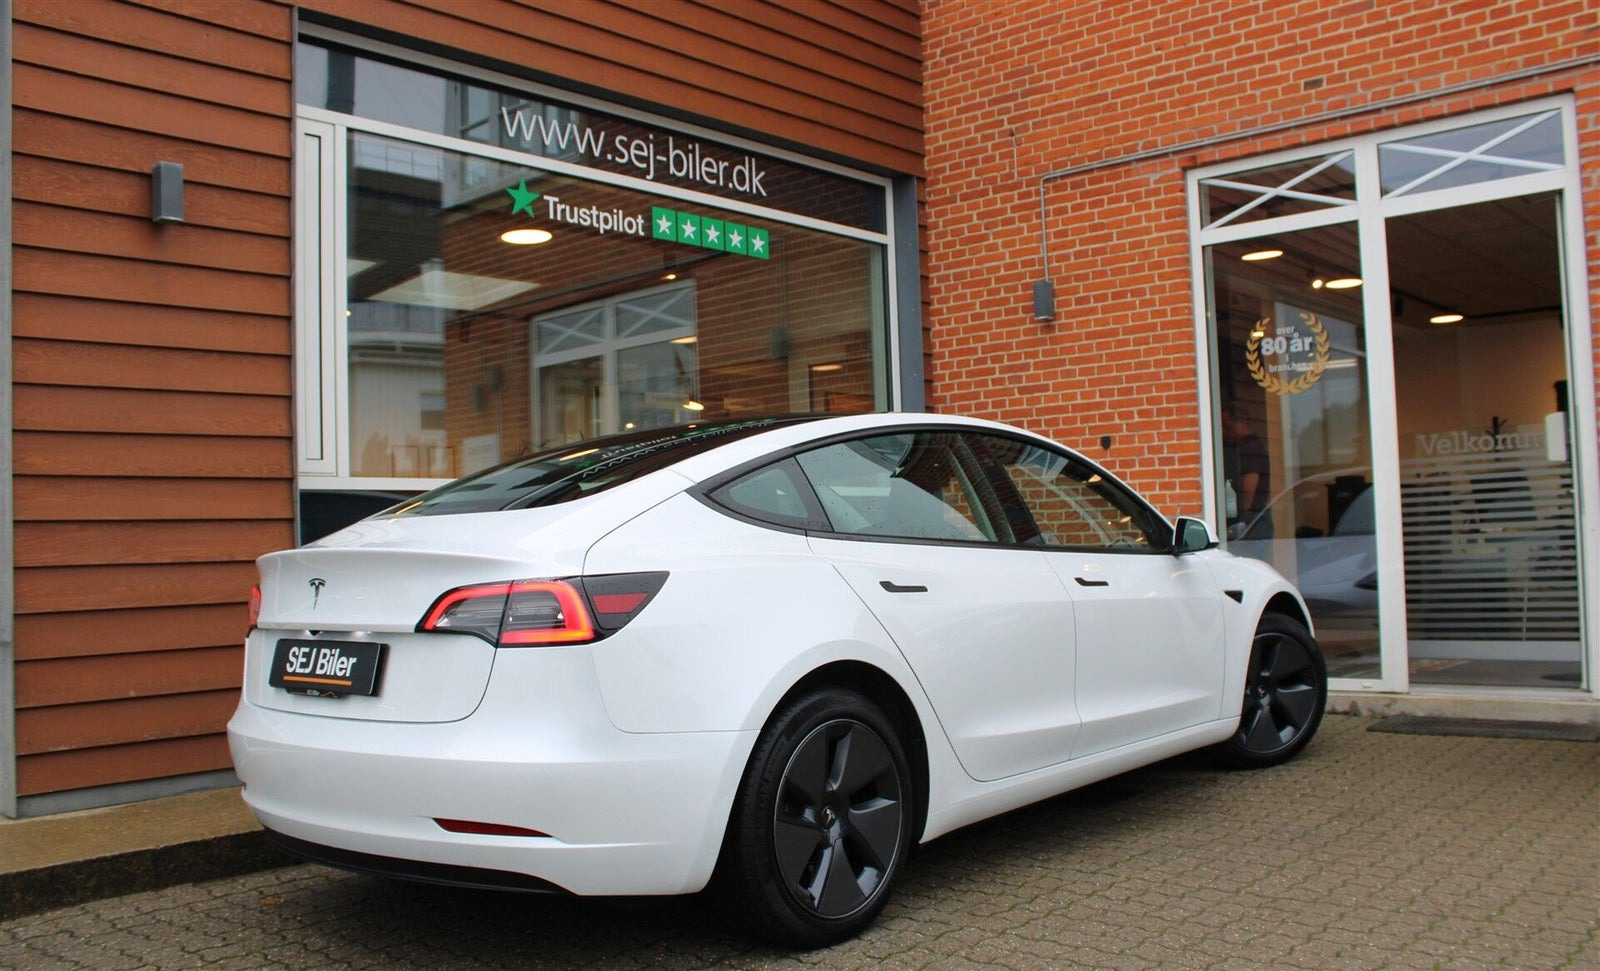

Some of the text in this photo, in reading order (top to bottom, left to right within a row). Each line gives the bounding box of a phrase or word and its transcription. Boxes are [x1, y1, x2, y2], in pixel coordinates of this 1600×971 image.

[502, 107, 767, 197] www.sej-biler.dk
[543, 195, 645, 236] Trustpilot
[1261, 332, 1313, 356] 80 år
[1417, 430, 1546, 455] Velkomm
[286, 646, 357, 677] SEJ Biler
